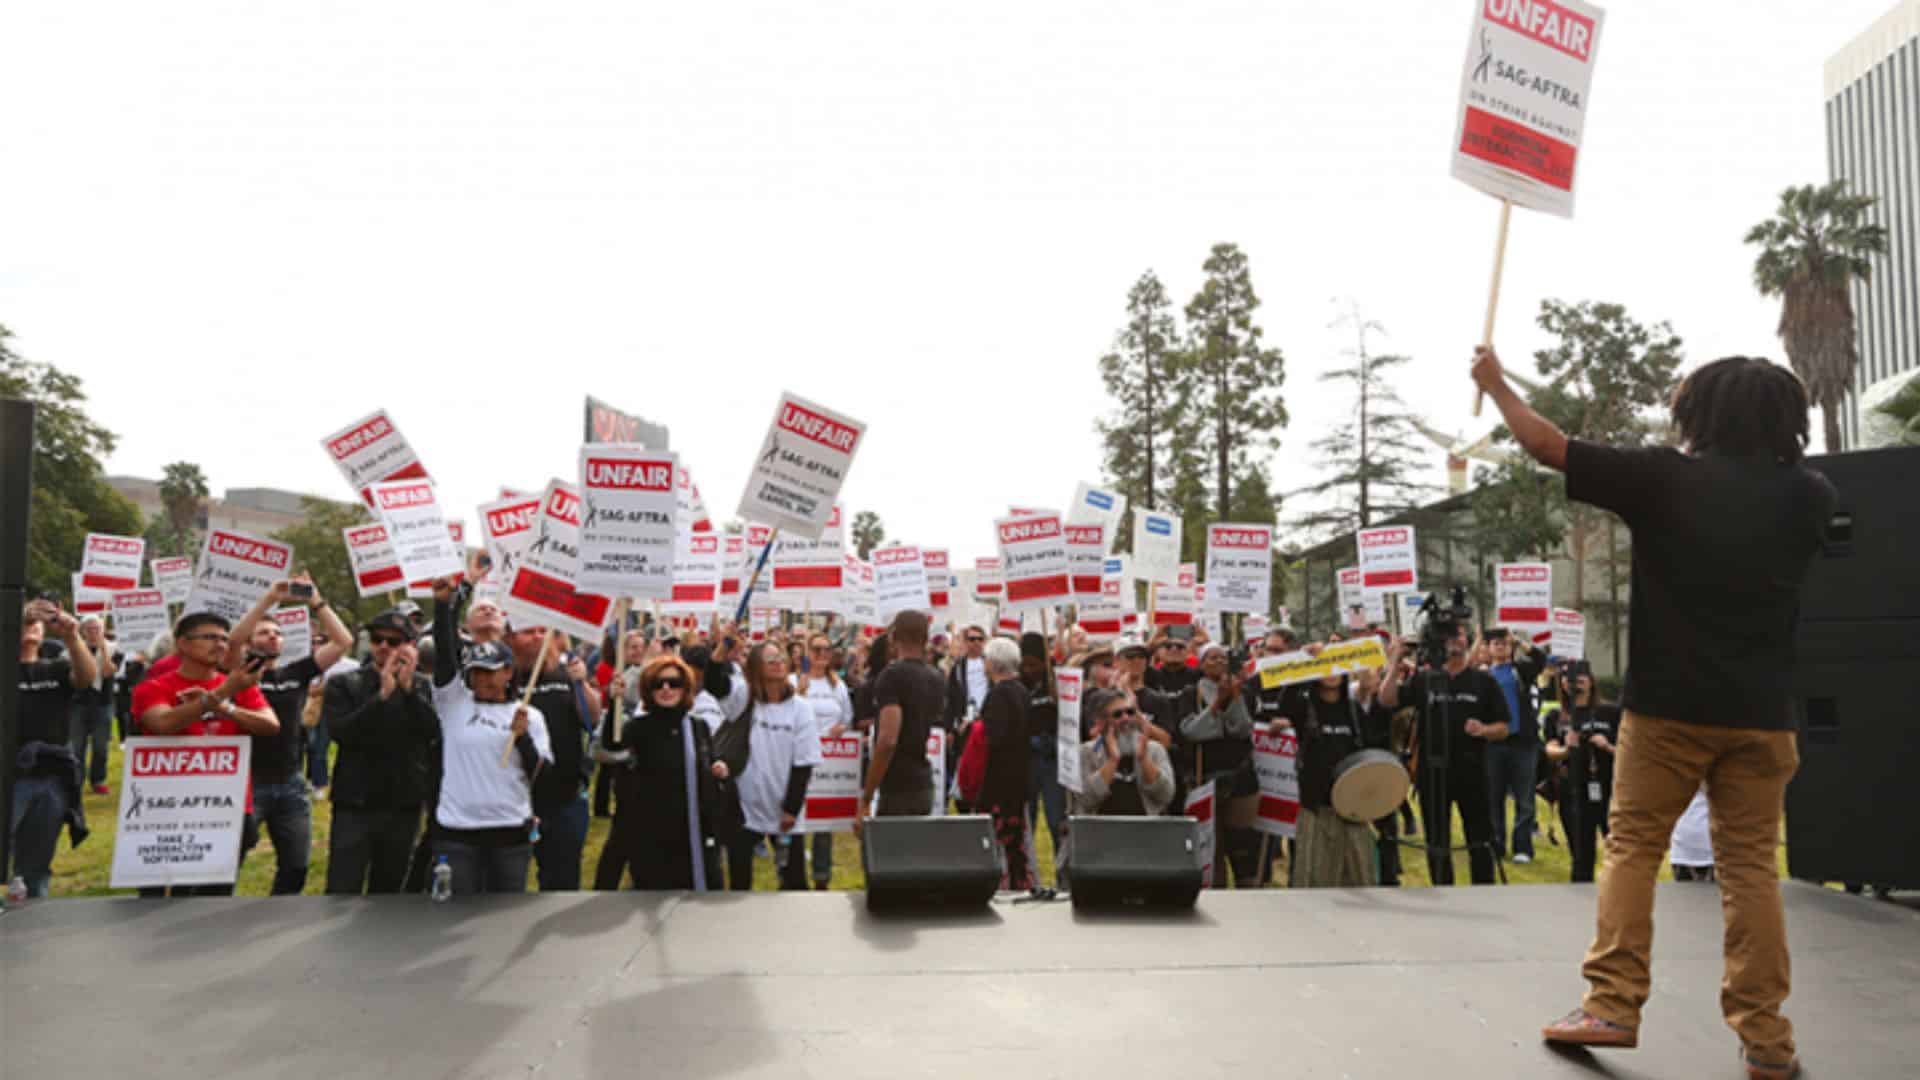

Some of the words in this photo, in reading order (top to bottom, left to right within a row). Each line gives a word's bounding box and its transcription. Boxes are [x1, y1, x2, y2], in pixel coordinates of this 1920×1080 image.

[1490, 0, 1589, 55] UNFAIR
[783, 407, 852, 449] UNFAIR
[587, 463, 670, 487] UNFAIR
[600, 508, 670, 524] SAG-AFTRA
[1001, 521, 1056, 543] UNFAIR
[211, 536, 285, 567] UNFAIR
[135, 750, 235, 774] UNFAIR
[146, 795, 234, 809] SAG-AFTRA
